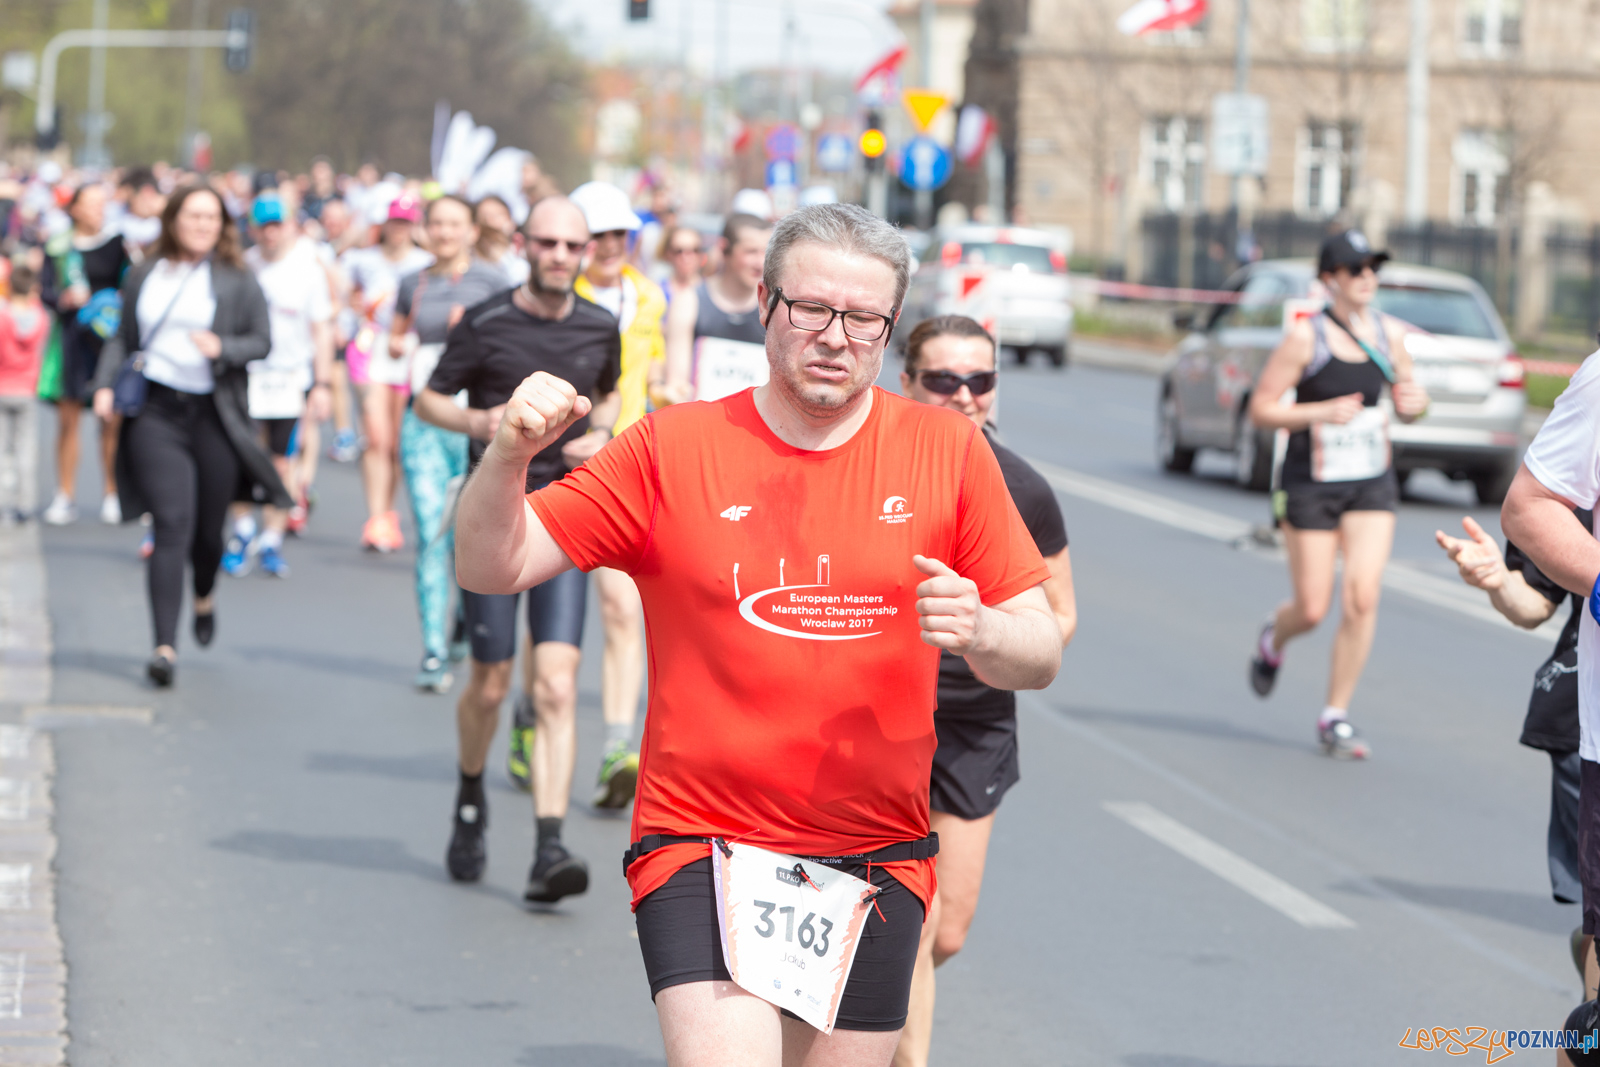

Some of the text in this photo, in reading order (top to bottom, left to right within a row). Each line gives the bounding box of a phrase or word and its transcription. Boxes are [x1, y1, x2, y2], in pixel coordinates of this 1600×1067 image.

[720, 505, 752, 521] 4F
[790, 593, 883, 604] European Masters
[772, 605, 898, 617] Marathon Championship
[800, 618, 874, 628] Wroclaw 2017
[753, 899, 834, 957] 3163
[780, 952, 806, 970] Jakub
